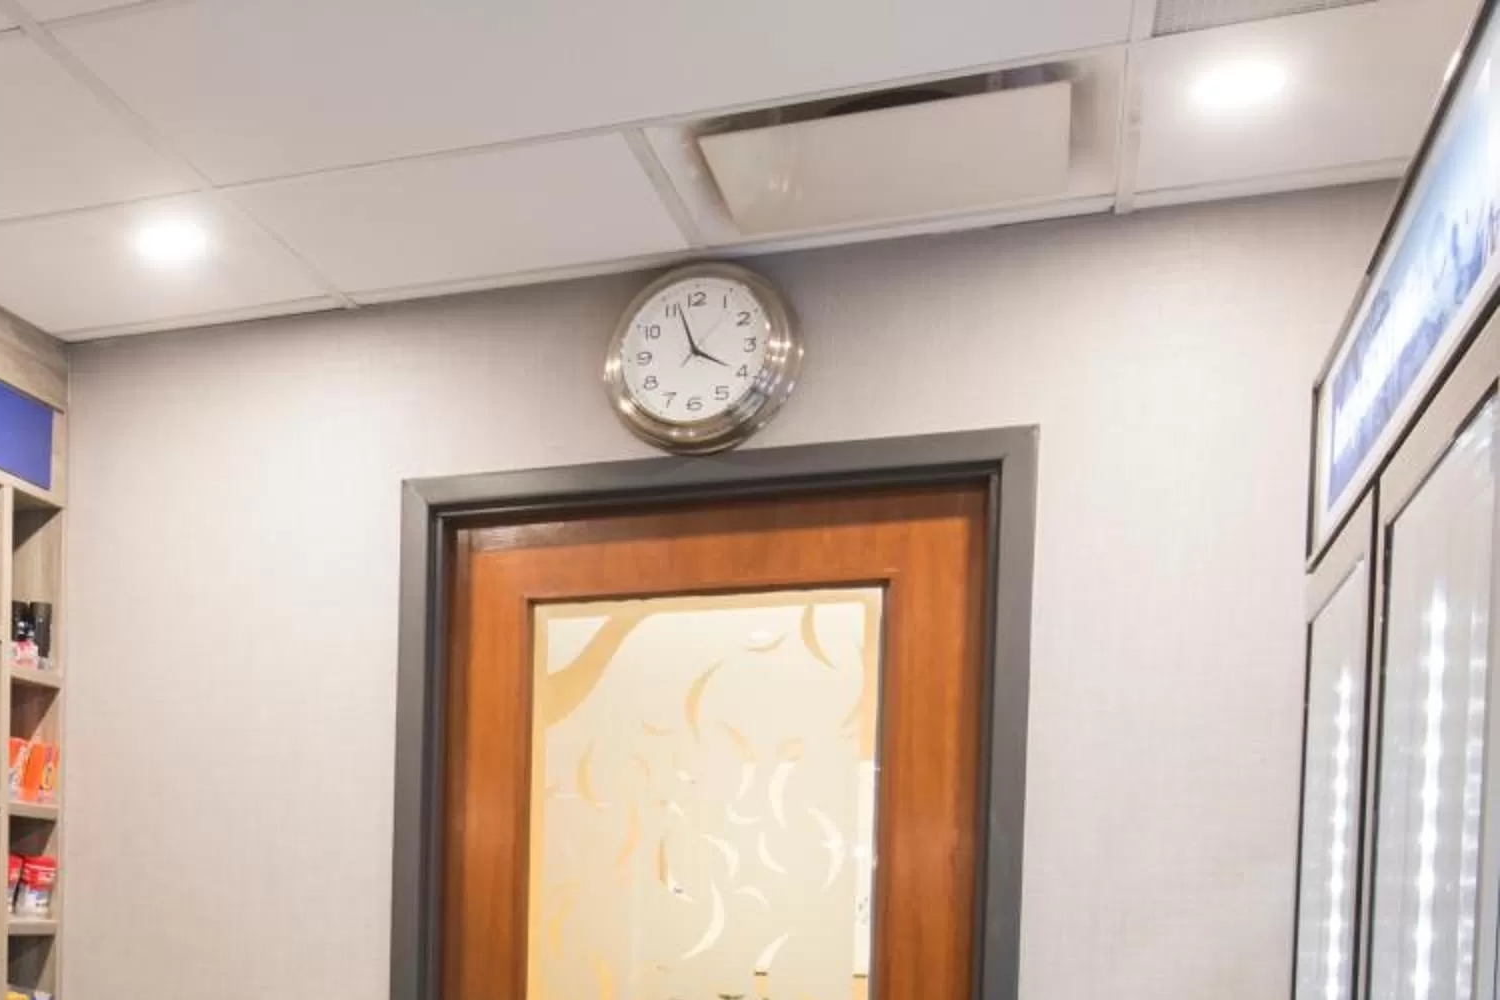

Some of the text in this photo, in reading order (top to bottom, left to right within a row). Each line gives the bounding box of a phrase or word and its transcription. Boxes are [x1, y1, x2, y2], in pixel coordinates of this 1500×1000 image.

[687, 291, 707, 308] 12
[736, 311, 751, 327] 2
[643, 324, 661, 340] 10
[743, 337, 757, 353] 3
[636, 352, 653, 366] 9
[735, 364, 749, 380] 4
[643, 376, 658, 391] 8
[662, 391, 677, 408] 7
[714, 386, 730, 401] 5
[686, 397, 703, 411] 6
